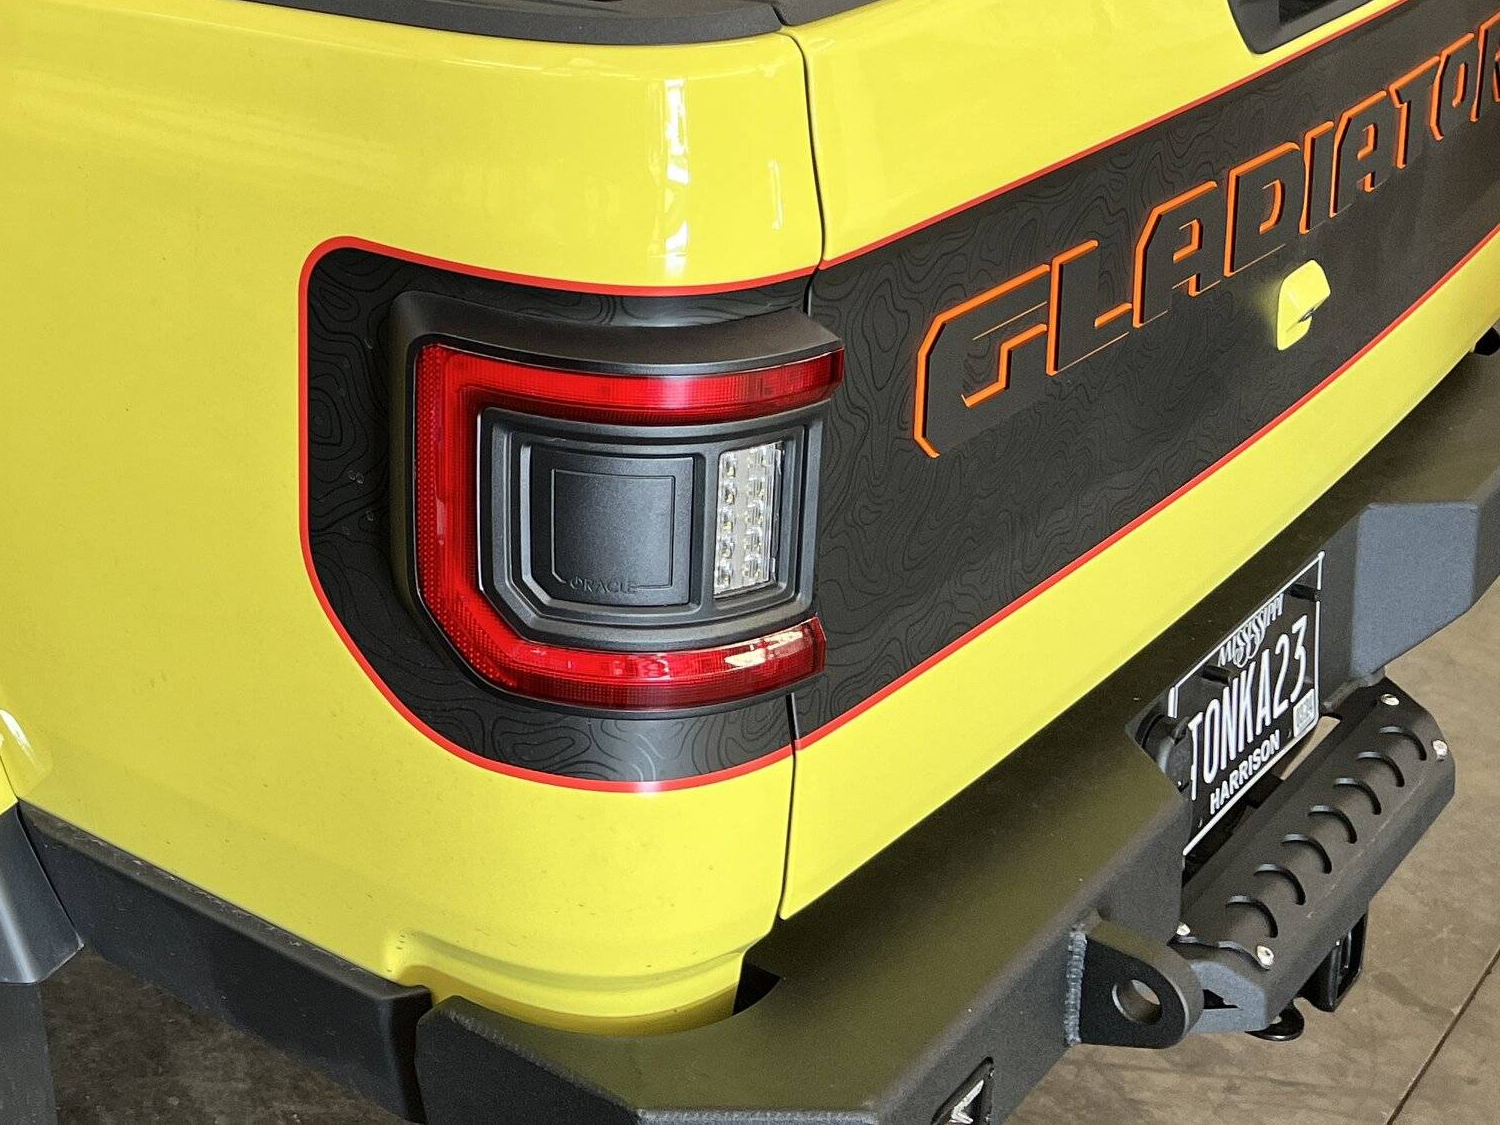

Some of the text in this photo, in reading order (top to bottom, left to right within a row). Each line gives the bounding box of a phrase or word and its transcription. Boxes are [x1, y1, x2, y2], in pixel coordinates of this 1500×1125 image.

[570, 576, 638, 594] ORACLE
[1188, 615, 1308, 801] TONKA23
[1210, 729, 1281, 815] HARRISON
